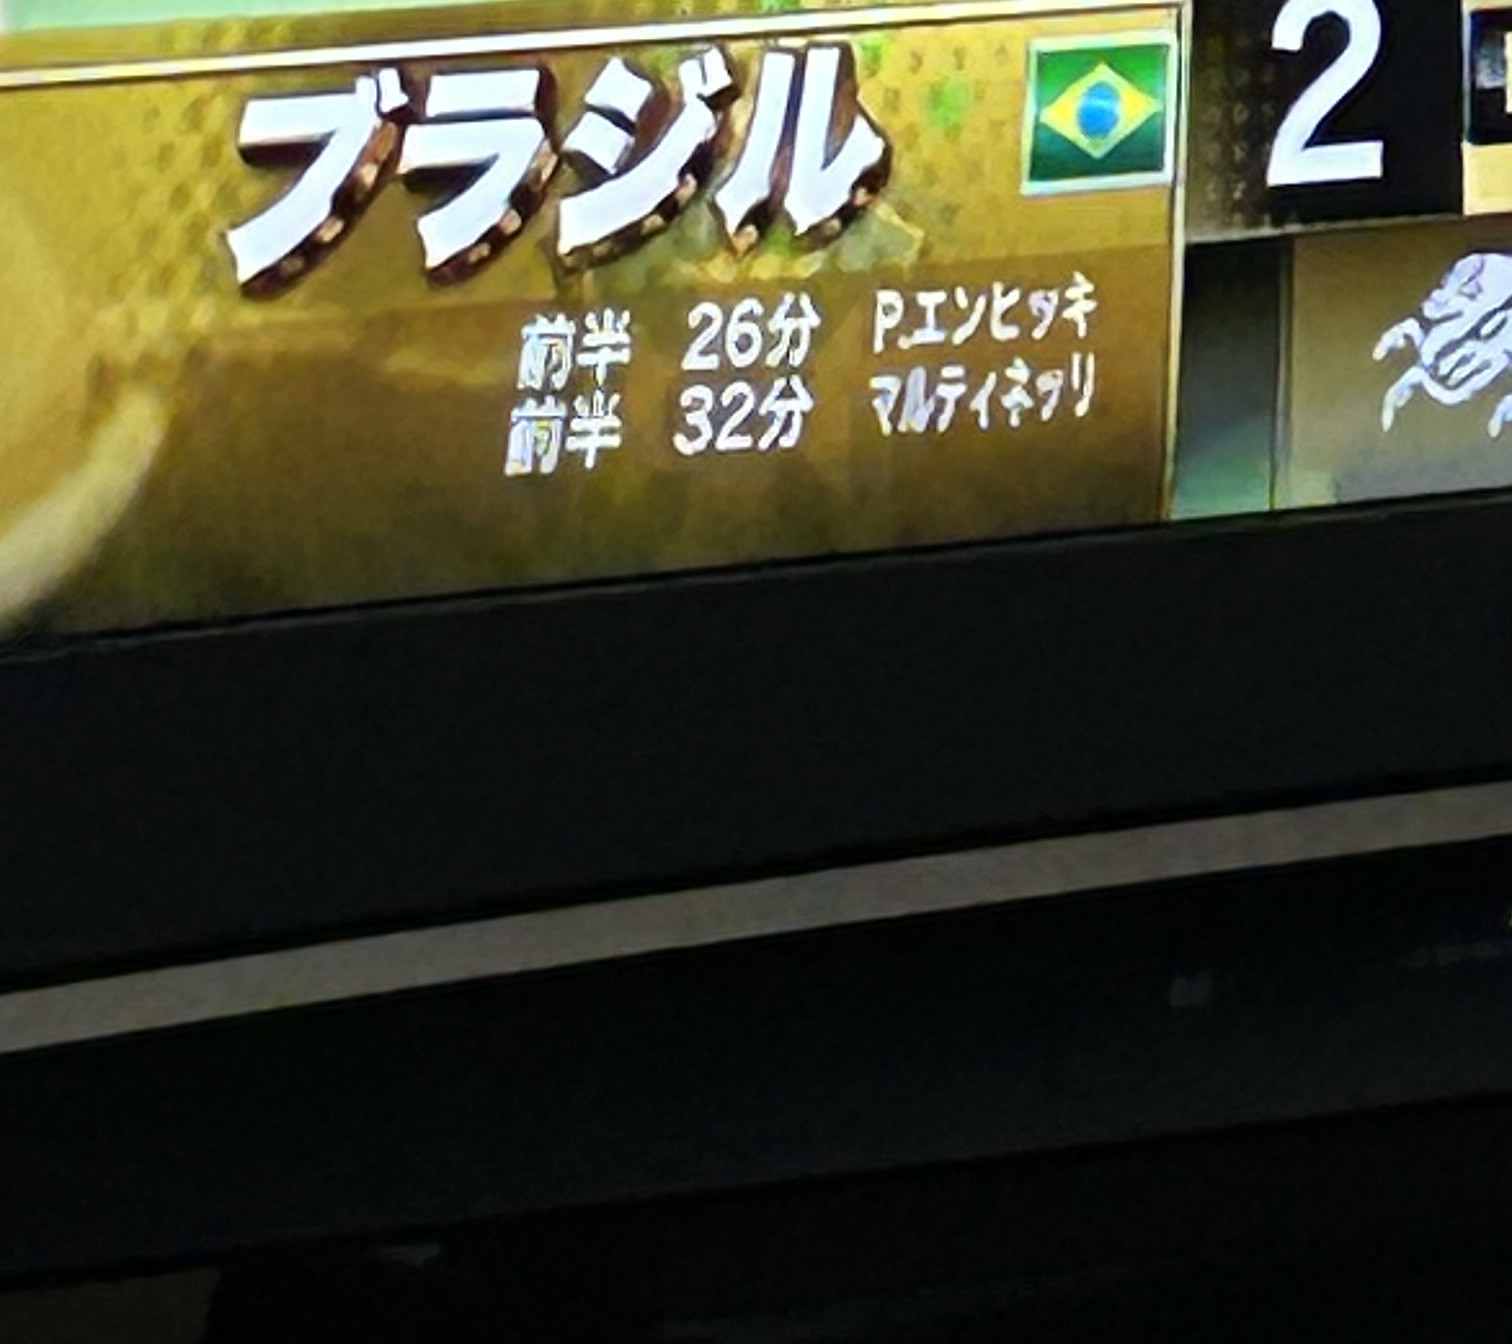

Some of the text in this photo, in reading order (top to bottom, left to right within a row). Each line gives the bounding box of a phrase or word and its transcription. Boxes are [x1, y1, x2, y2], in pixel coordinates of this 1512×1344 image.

[226, 42, 888, 294] ブラジル
[517, 308, 632, 390] 前半
[680, 292, 822, 371] 26分
[504, 388, 623, 477] 前半
[673, 374, 815, 456] 32分
